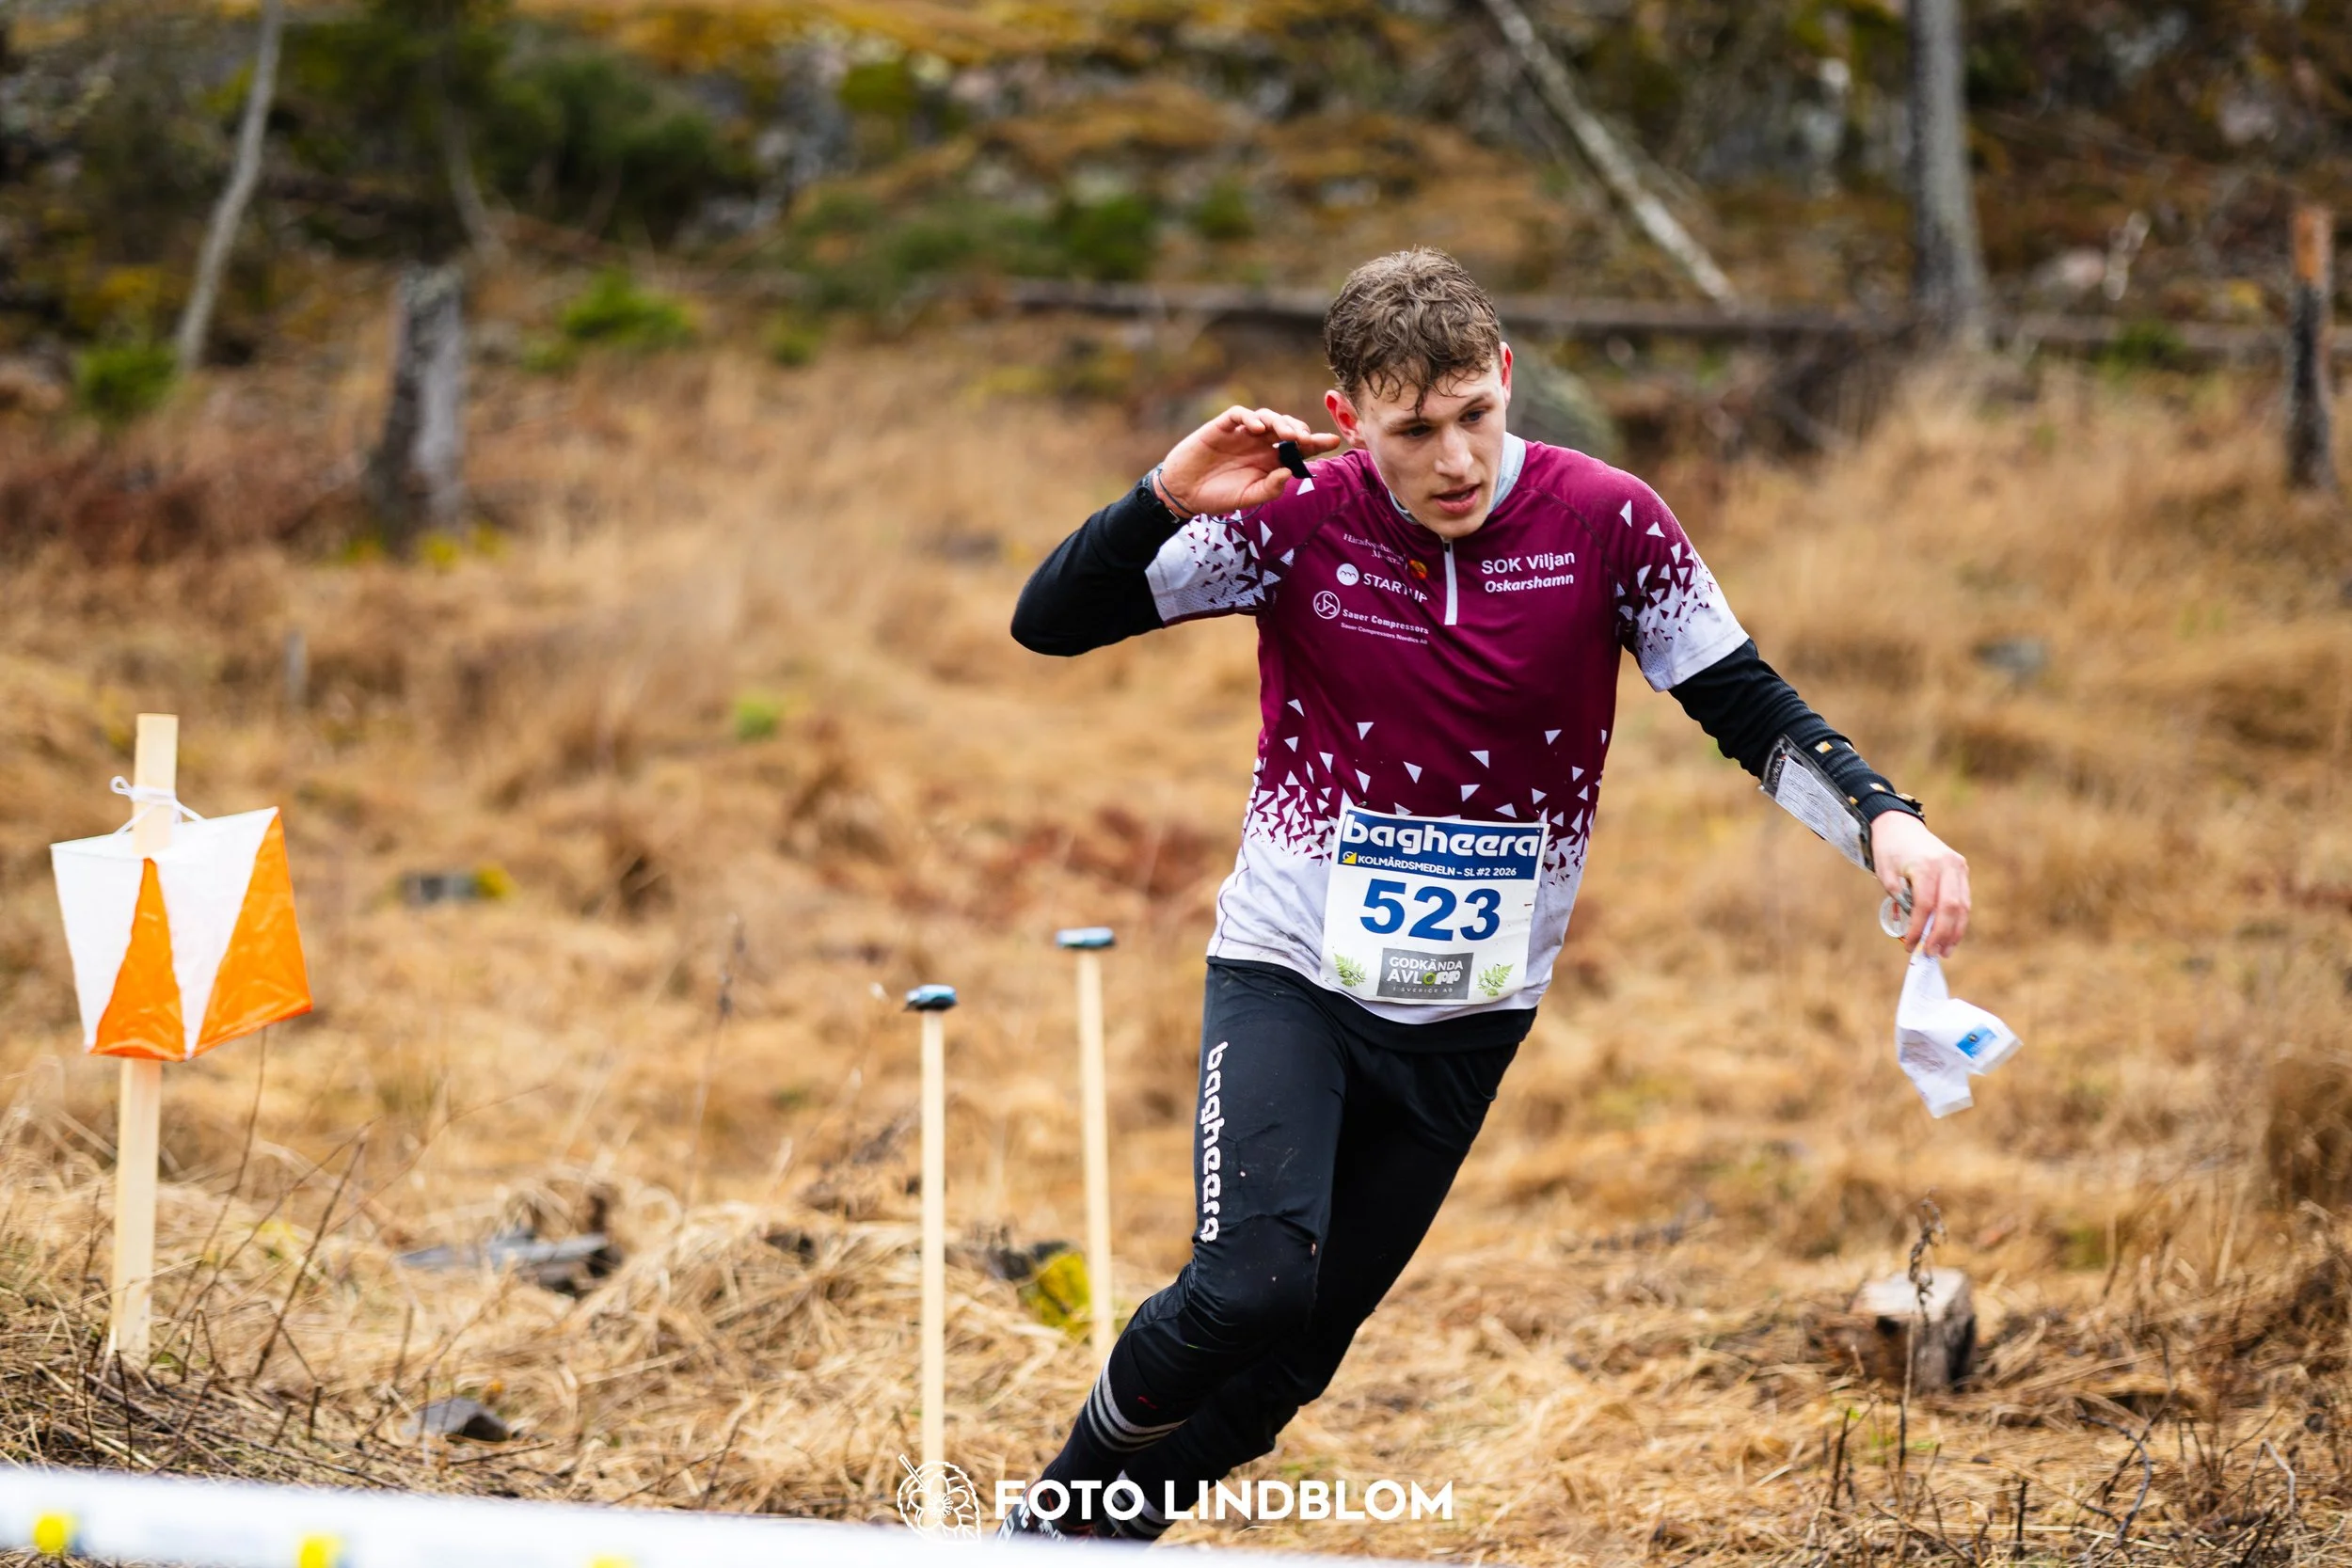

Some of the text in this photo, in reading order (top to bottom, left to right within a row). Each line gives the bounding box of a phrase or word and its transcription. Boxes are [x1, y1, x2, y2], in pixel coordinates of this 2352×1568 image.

[1481, 552, 1575, 575] SOK Viljan
[1485, 574, 1574, 593] Oskarshamn
[1343, 609, 1429, 634] Sauer Compressors
[1342, 815, 1540, 857] bagheera
[1358, 855, 1455, 876] KOLMÅRDSMEDELN
[1464, 868, 1475, 877] SL
[1476, 867, 1491, 877] #2
[1493, 867, 1518, 877] 2026
[1359, 879, 1502, 942] 523
[1389, 956, 1464, 972] GODKÄNDA
[1200, 1041, 1228, 1243] bagheera
